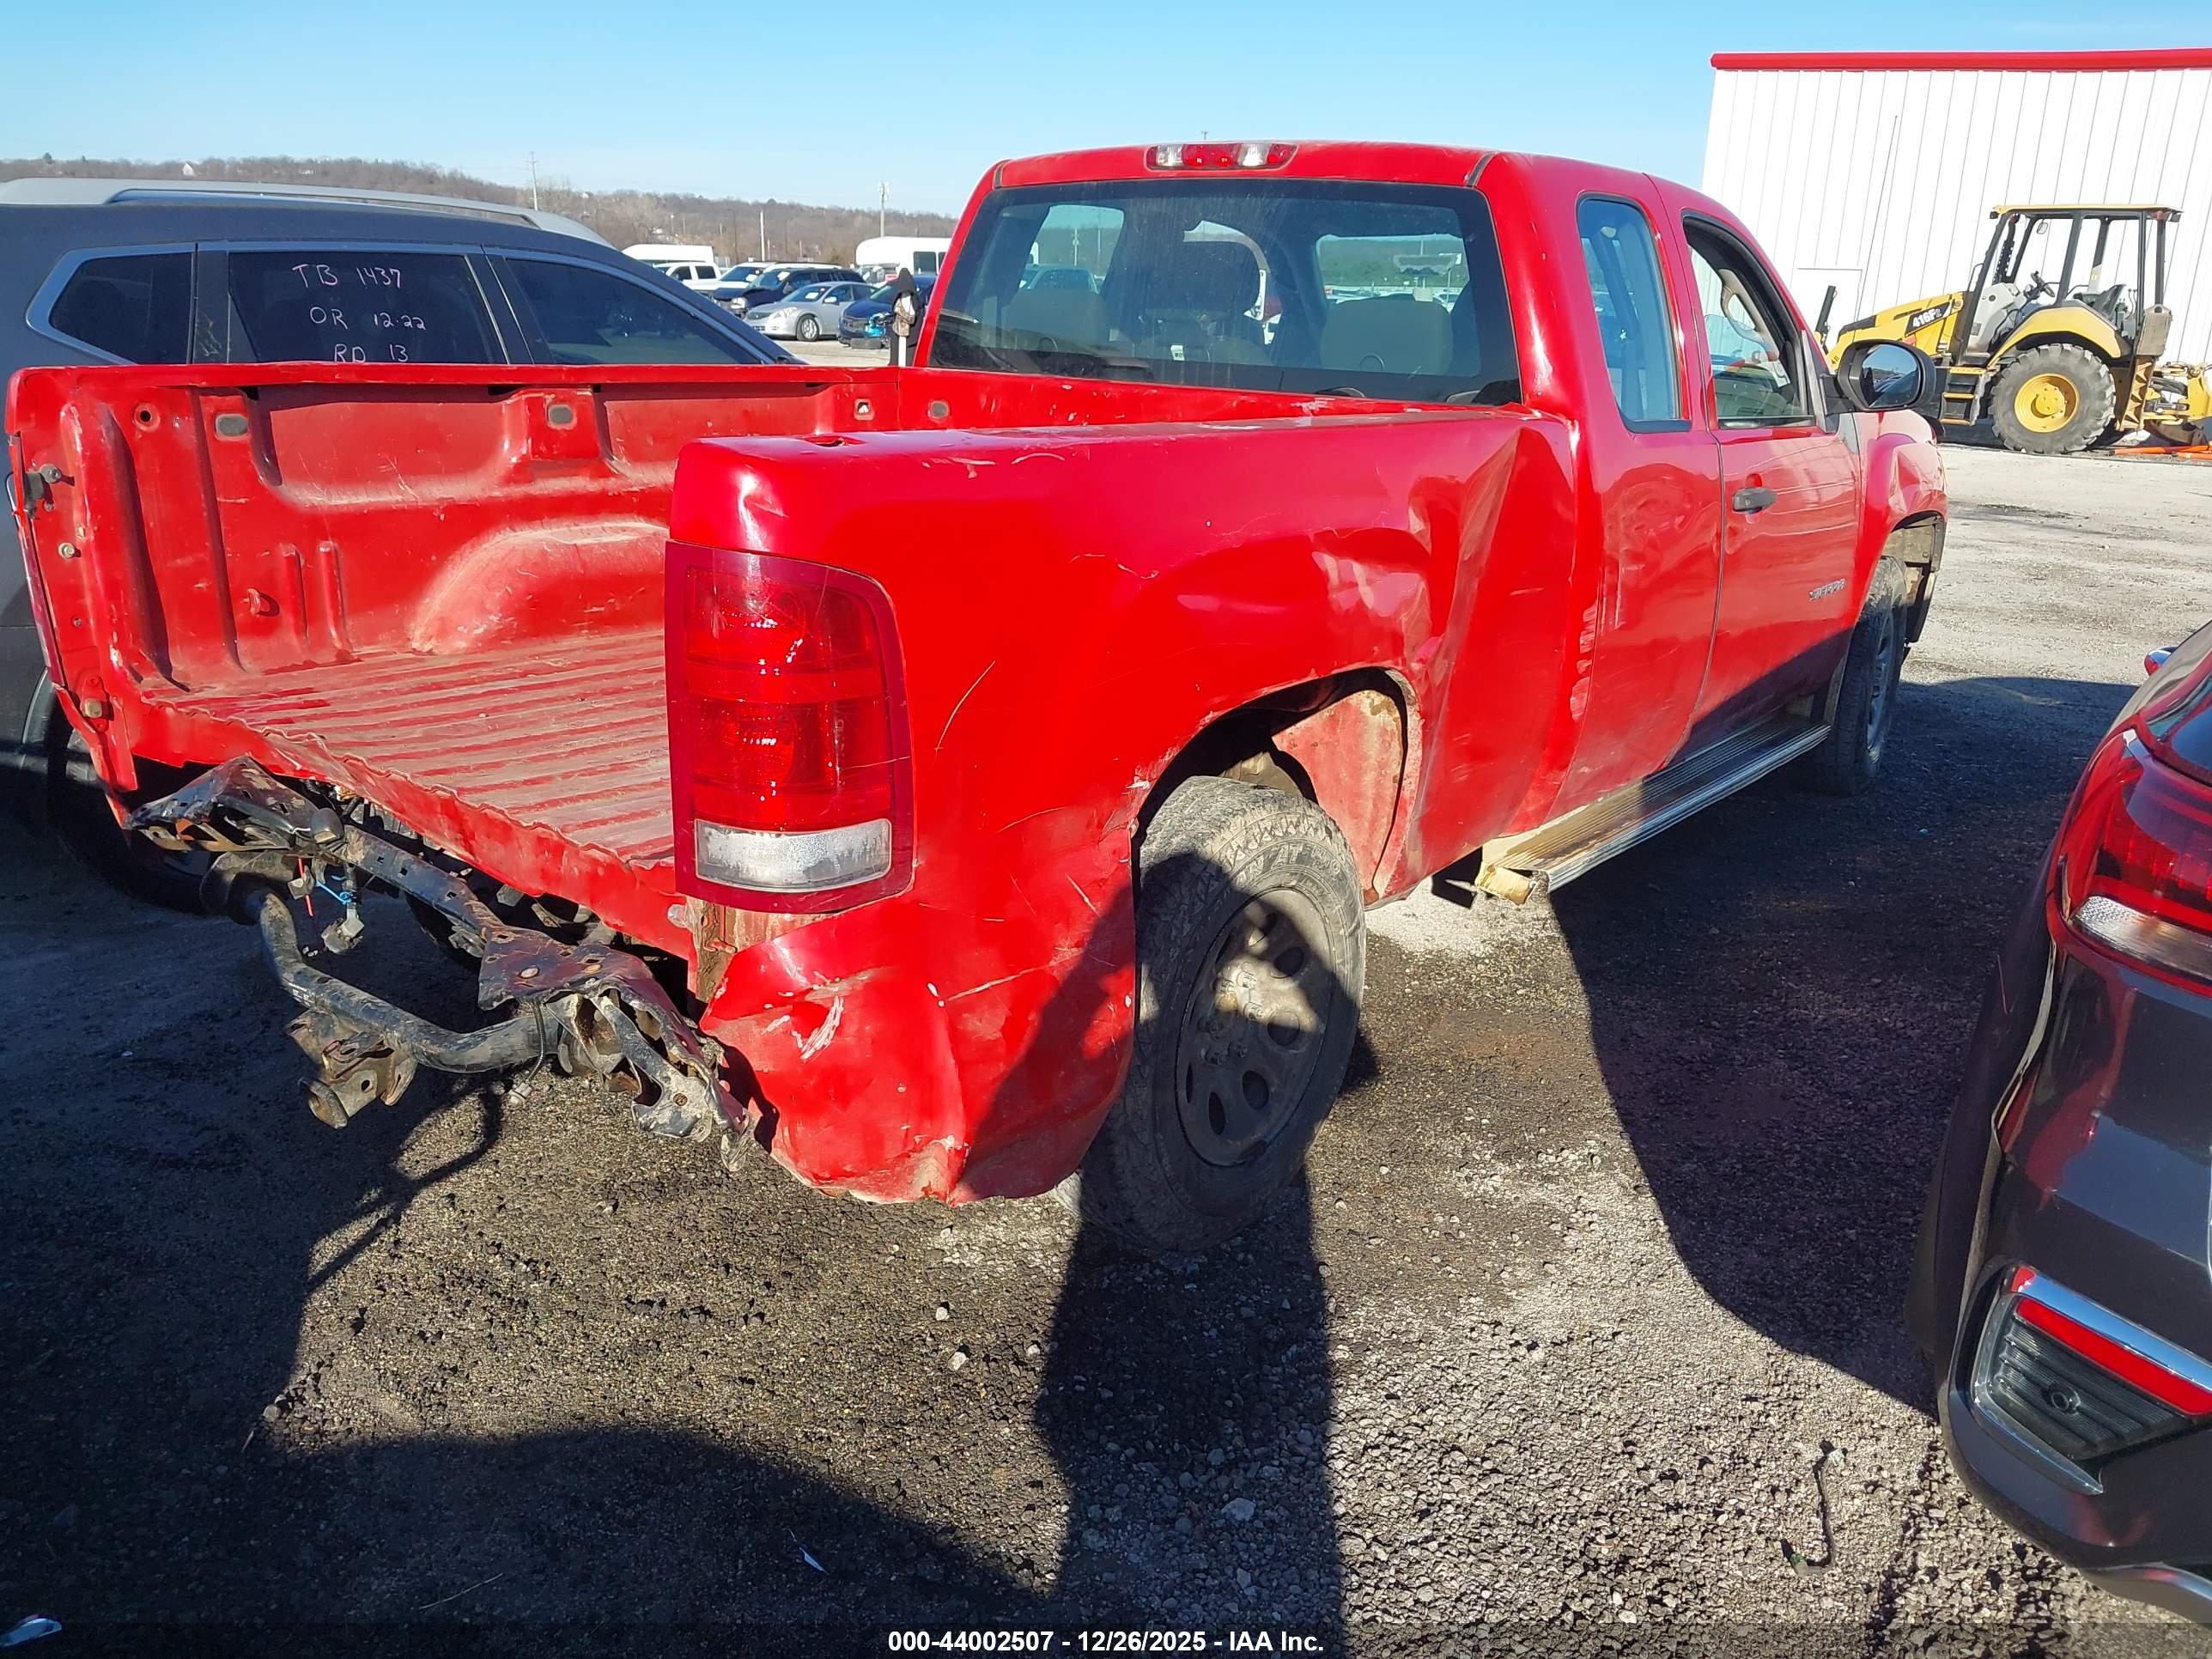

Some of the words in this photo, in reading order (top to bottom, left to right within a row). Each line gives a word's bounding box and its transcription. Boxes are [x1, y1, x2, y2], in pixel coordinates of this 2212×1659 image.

[292, 264, 338, 288] TB
[356, 266, 401, 289] 1437
[309, 307, 349, 330] OR
[334, 343, 366, 363] RD
[389, 343, 409, 362] 13
